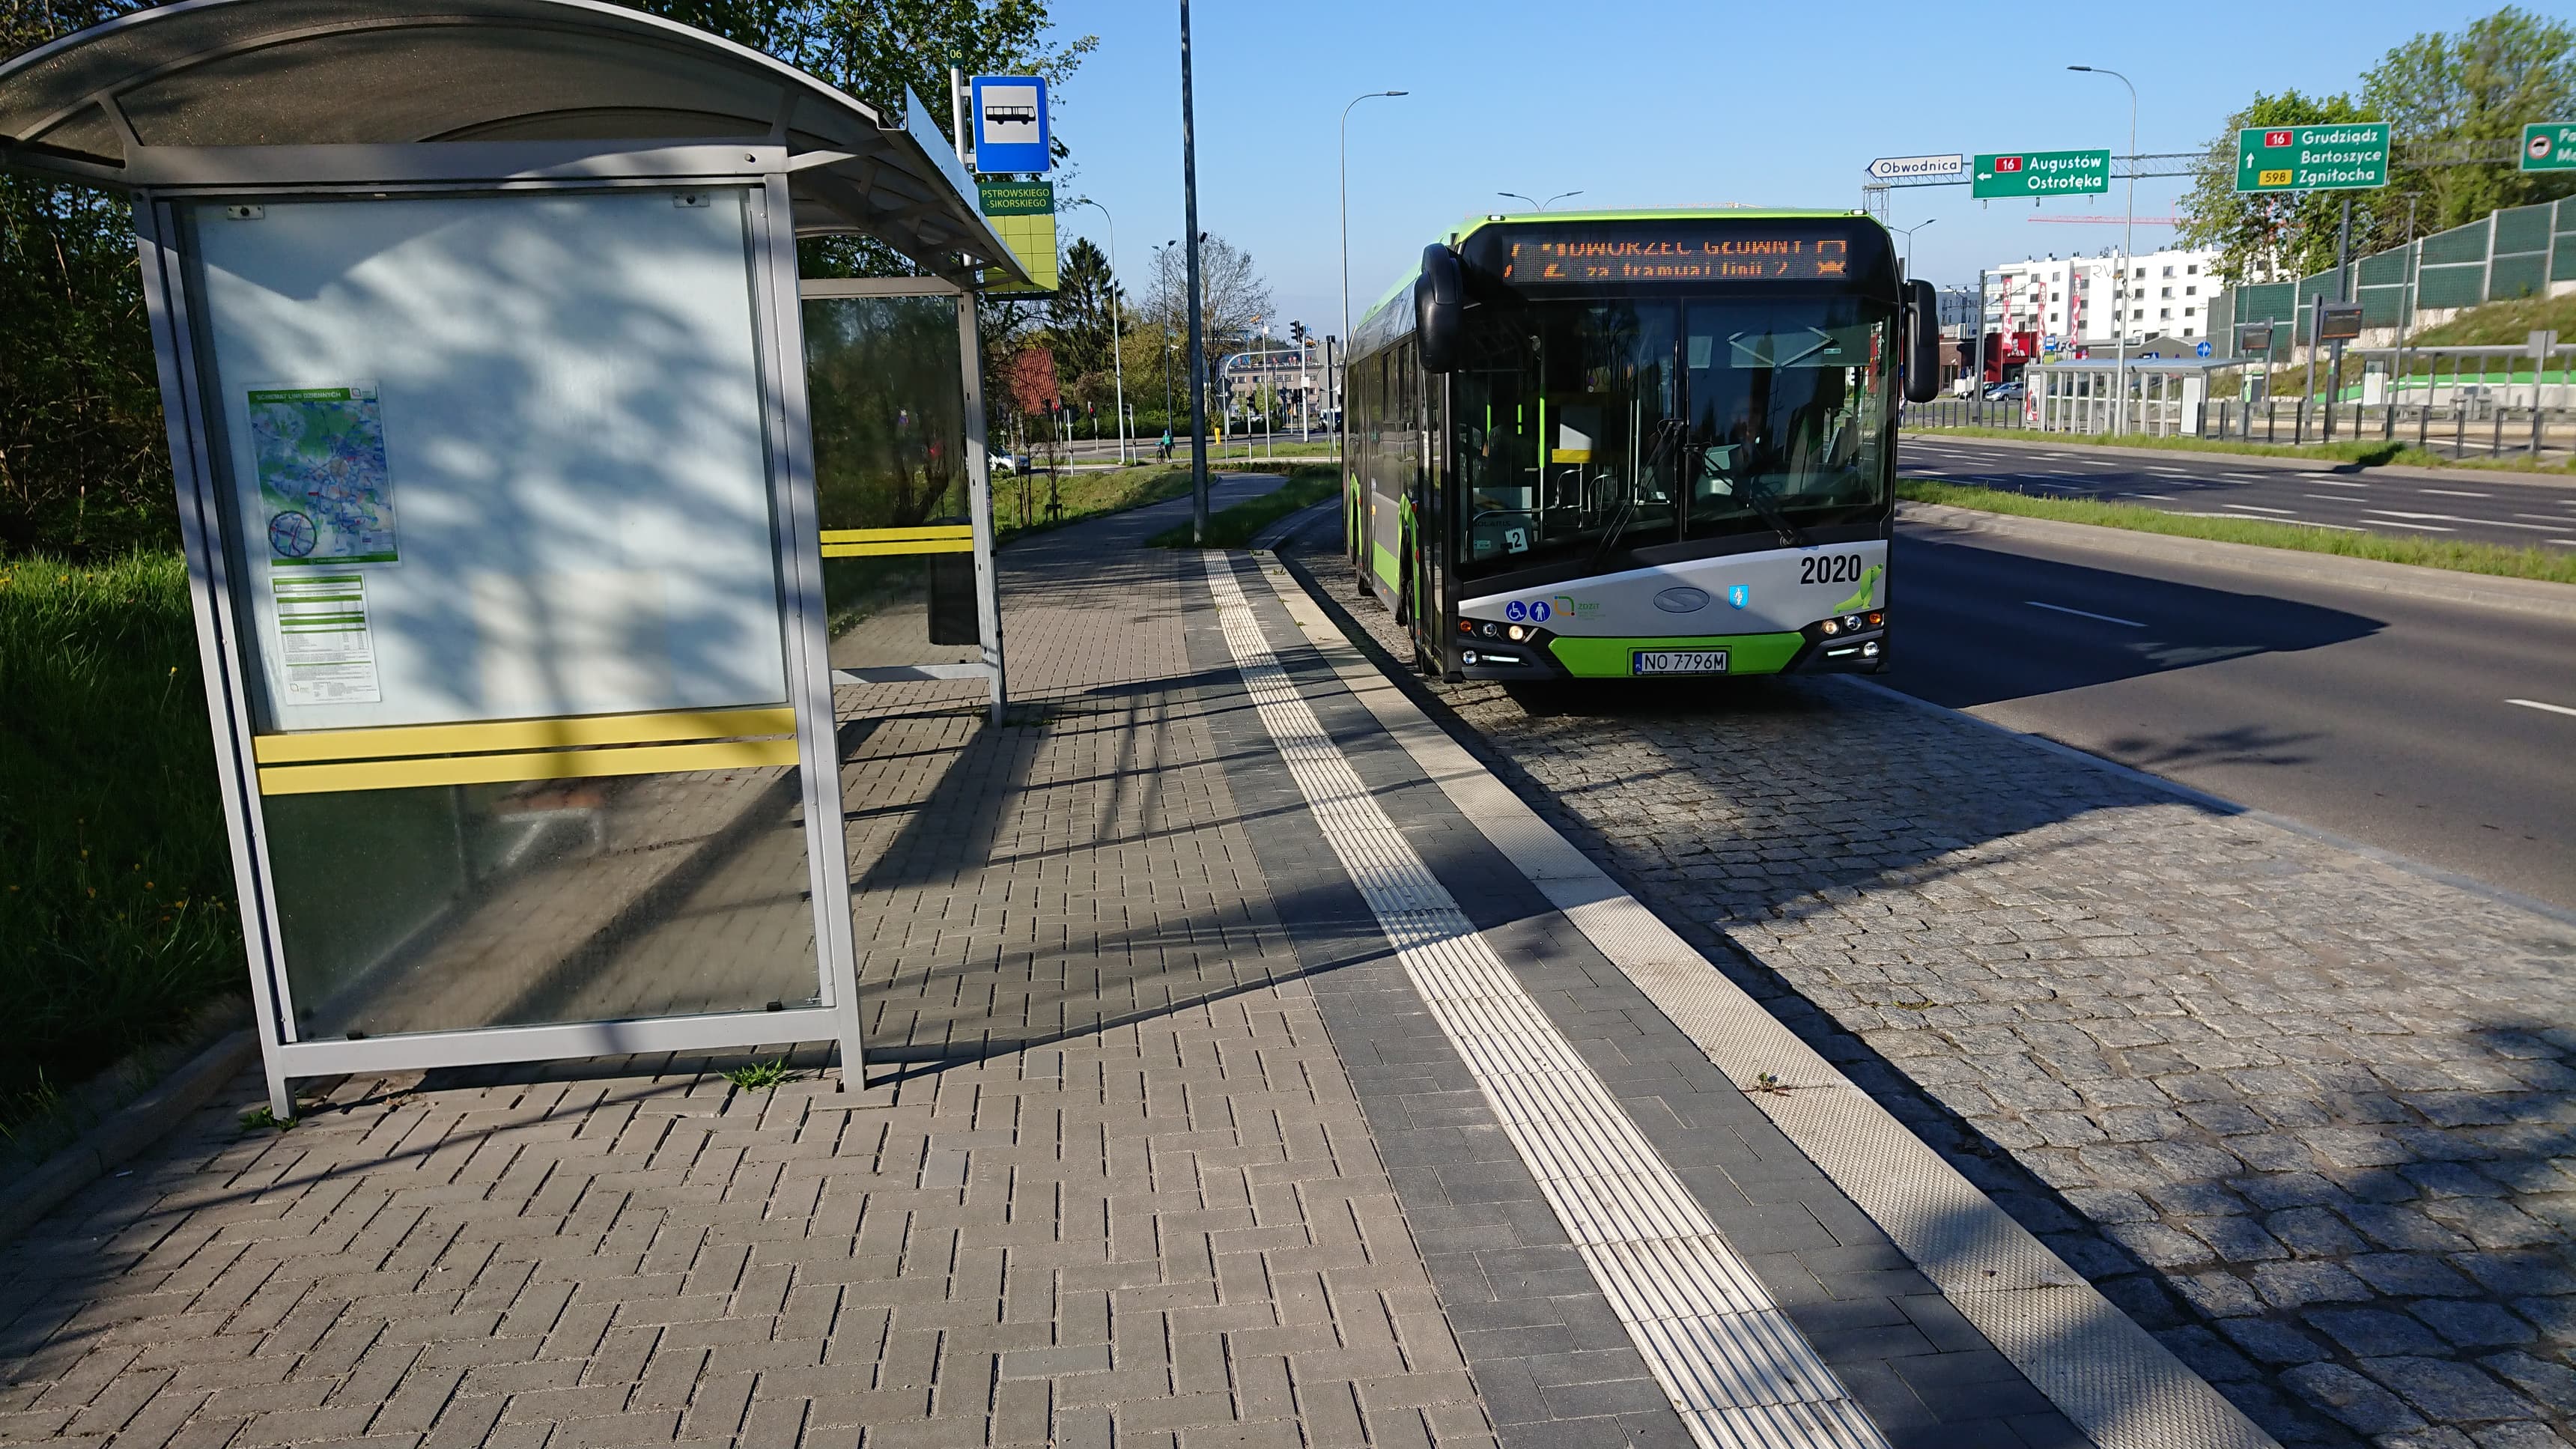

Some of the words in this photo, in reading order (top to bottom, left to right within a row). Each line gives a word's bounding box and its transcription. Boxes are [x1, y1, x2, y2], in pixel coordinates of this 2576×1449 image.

[2272, 133, 2285, 145] 16
[2301, 128, 2378, 145] Grudziądz
[2002, 159, 2015, 171] 16
[2029, 155, 2102, 173] Augustów
[2300, 150, 2382, 165] Bartoszyce
[1880, 159, 1957, 174] Obwodnica
[2027, 174, 2102, 190] Ostrołęka
[2264, 171, 2286, 183] 598
[2299, 167, 2375, 186] Zgniłocha
[982, 189, 1050, 198] PSTROWSKIEGO
[986, 198, 1047, 208] -SIKORSKIEGO
[2055, 341, 2075, 351] FC
[303, 391, 341, 399] DZIENNYCH
[1512, 532, 1522, 548] 2
[1800, 555, 1862, 585] 2020
[1644, 654, 1668, 669] NO
[1674, 653, 1725, 669] 7796M
